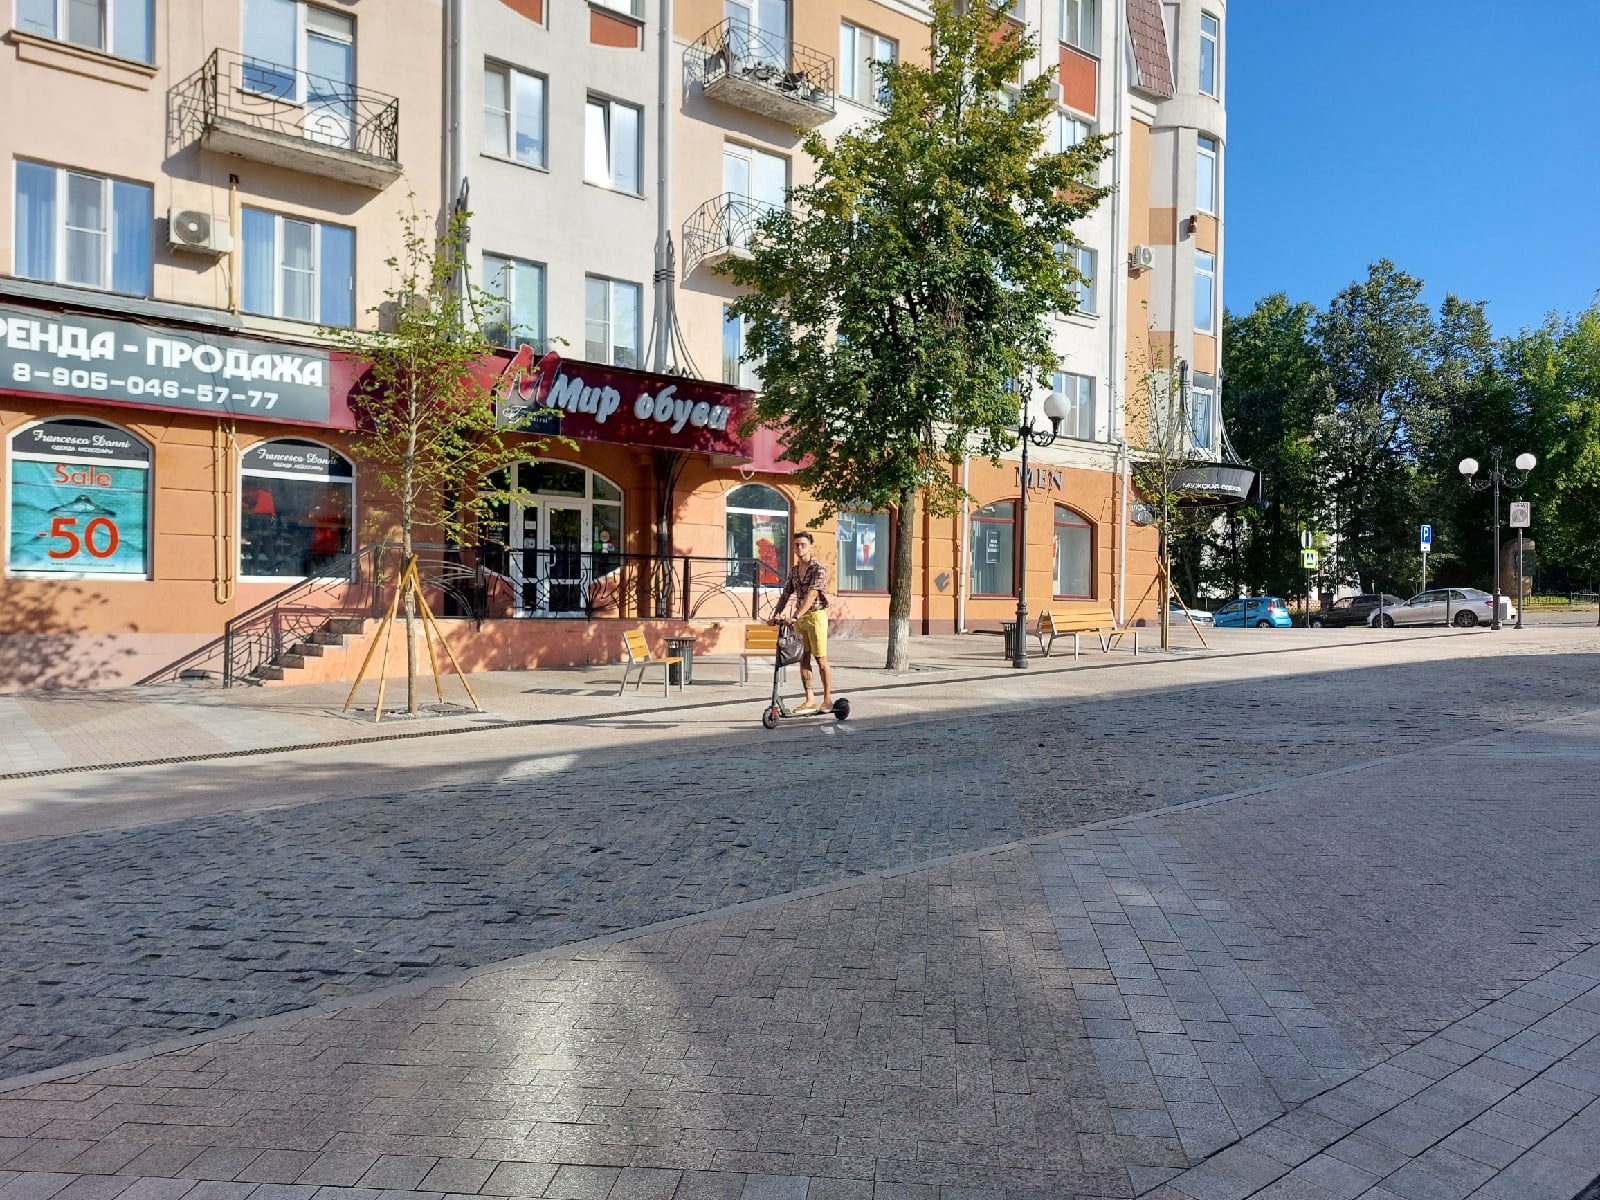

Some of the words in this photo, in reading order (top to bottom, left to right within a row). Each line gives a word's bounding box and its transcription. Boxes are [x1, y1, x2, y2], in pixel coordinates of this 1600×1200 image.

[147, 337, 322, 387] ПРОДАЖА
[12, 362, 279, 410] 8-905-046-57-77
[546, 373, 620, 424] Мир
[633, 384, 730, 434] обуви
[32, 429, 91, 445] Francesco
[257, 448, 304, 463] Francesco
[54, 463, 112, 487] Sale
[1014, 465, 1064, 491] MEN
[37, 516, 119, 559] -50
